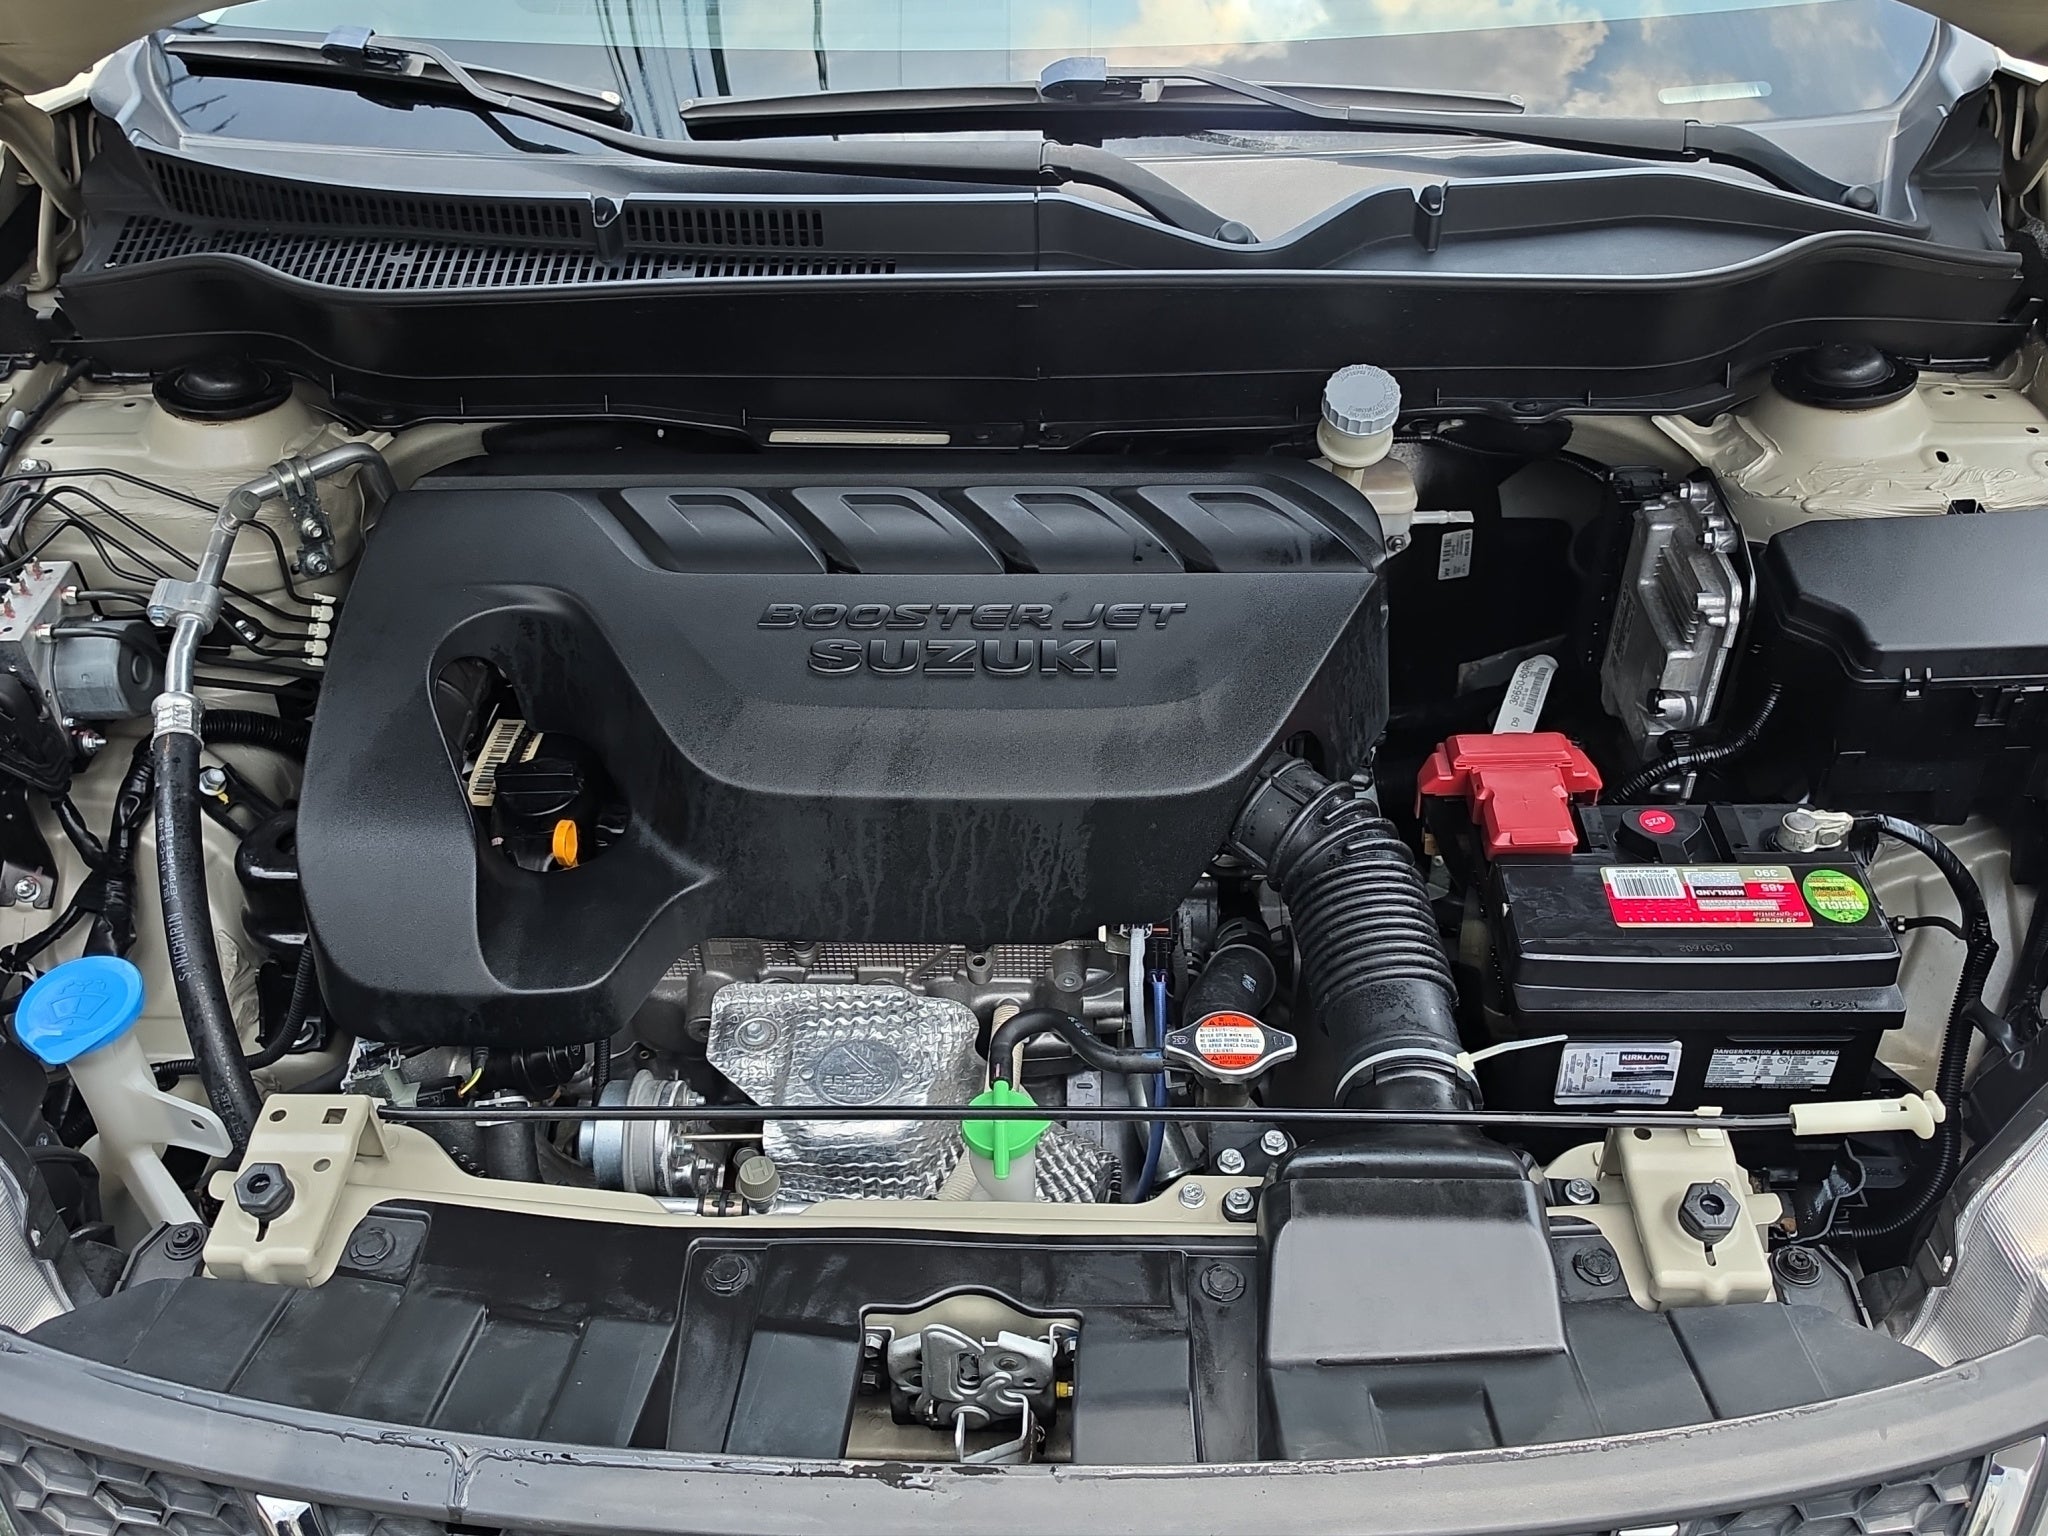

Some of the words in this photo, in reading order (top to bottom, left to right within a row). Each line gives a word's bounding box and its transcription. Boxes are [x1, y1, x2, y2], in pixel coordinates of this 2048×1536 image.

[757, 603, 1053, 630] BOOSTER
[1062, 602, 1188, 630] JET
[808, 638, 1118, 674] SUZUKI
[1754, 869, 1779, 877] 390
[1760, 883, 1785, 892] 485
[1817, 900, 1865, 909] RECICLA
